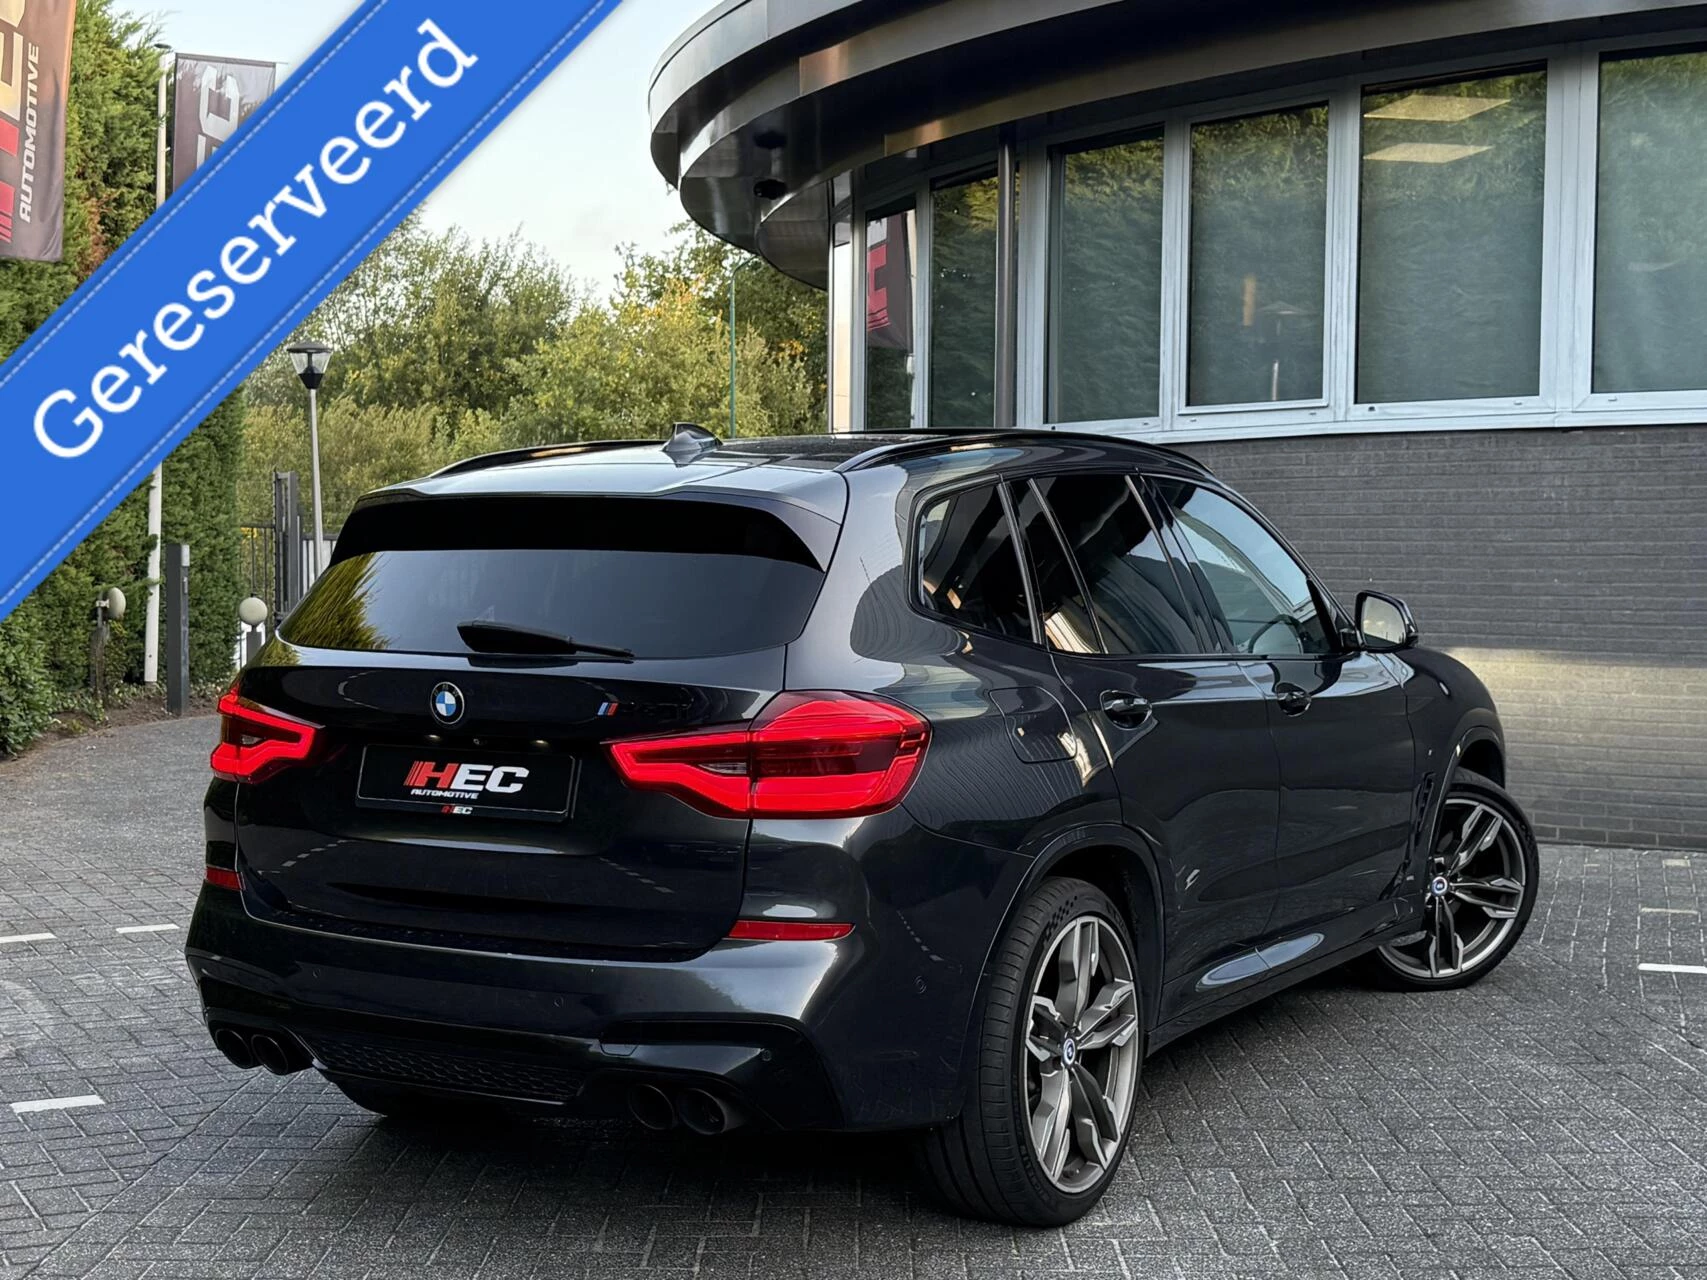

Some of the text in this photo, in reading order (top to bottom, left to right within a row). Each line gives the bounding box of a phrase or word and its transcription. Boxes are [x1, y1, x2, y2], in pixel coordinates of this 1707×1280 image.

[19, 43, 39, 223] AUTOMOTIVE
[403, 760, 530, 793] HEC
[410, 788, 480, 800] AUTOMOTIVE
